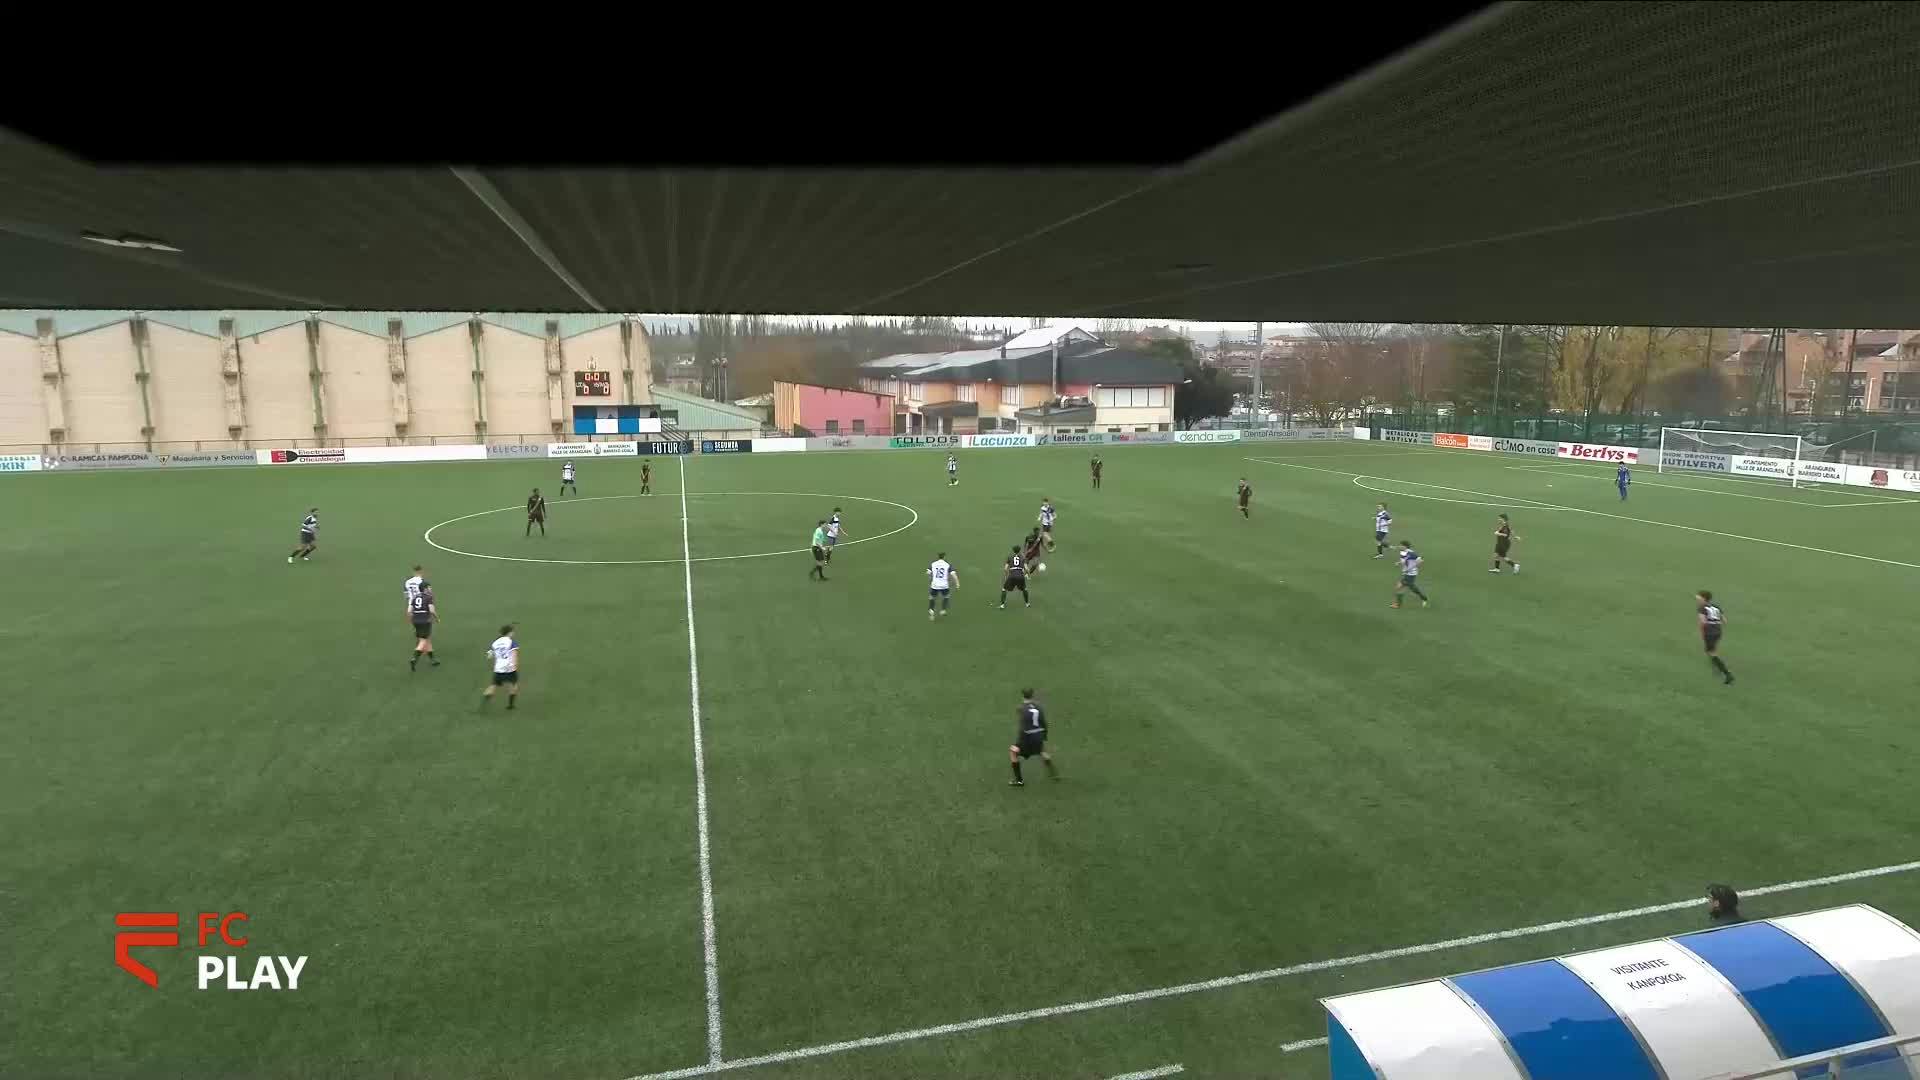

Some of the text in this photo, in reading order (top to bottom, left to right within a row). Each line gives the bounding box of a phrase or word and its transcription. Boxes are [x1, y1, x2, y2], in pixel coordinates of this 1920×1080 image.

[896, 436, 958, 445] TOLDOS
[1053, 434, 1086, 442] talleres
[1180, 431, 1214, 441] denda
[1538, 446, 1556, 455] casa
[1570, 444, 1625, 461] Berlys
[1013, 556, 1020, 566] 6
[414, 597, 422, 608] 9
[1610, 959, 1669, 976] VISITANTE
[1626, 973, 1687, 991] KANPOKOA
